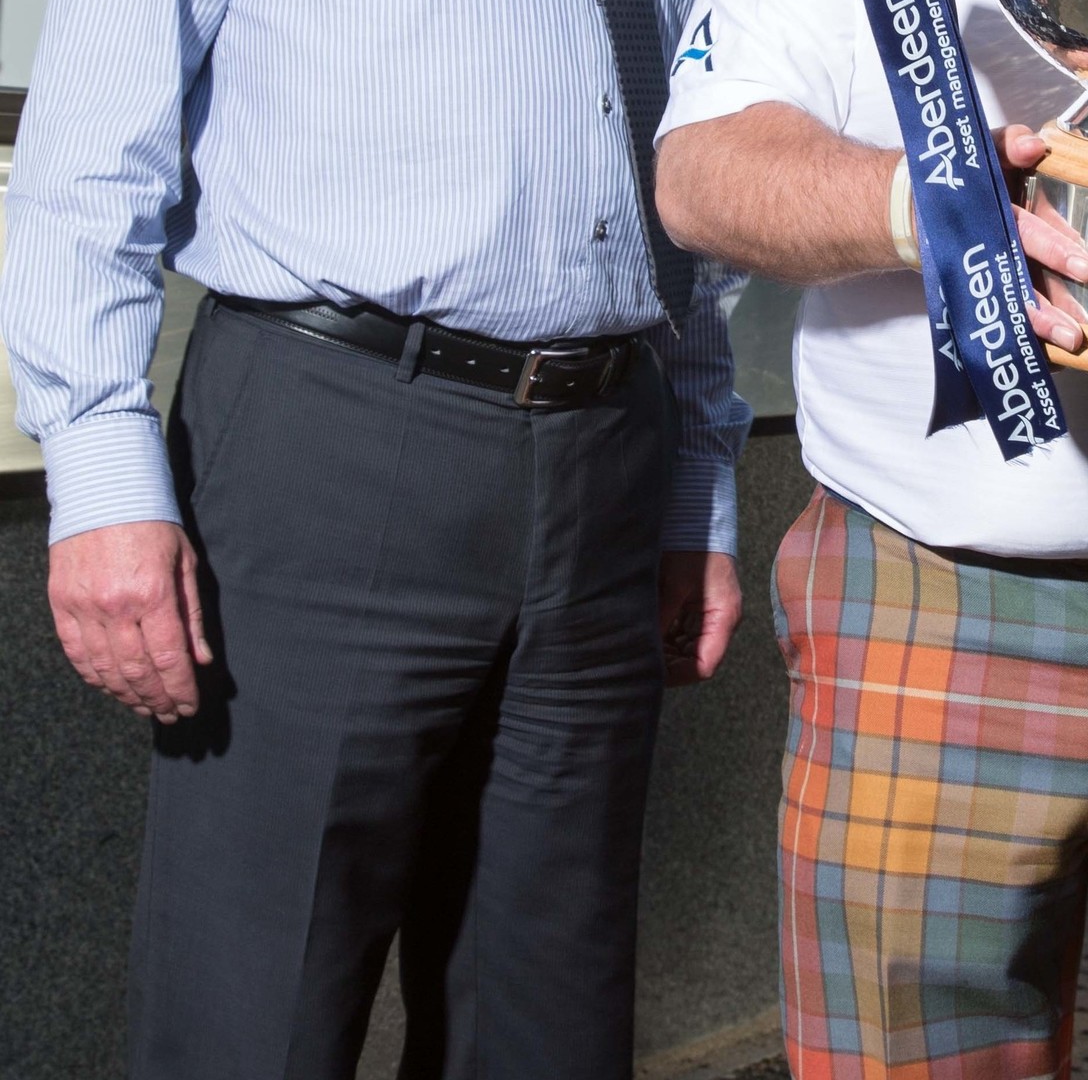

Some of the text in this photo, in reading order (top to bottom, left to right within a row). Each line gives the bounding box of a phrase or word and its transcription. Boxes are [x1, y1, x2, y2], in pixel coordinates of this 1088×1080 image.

[956, 117, 980, 169] Asset
[962, 242, 1045, 447] Aberdeen
[995, 251, 1041, 375] management
[1032, 378, 1061, 431] Asset
